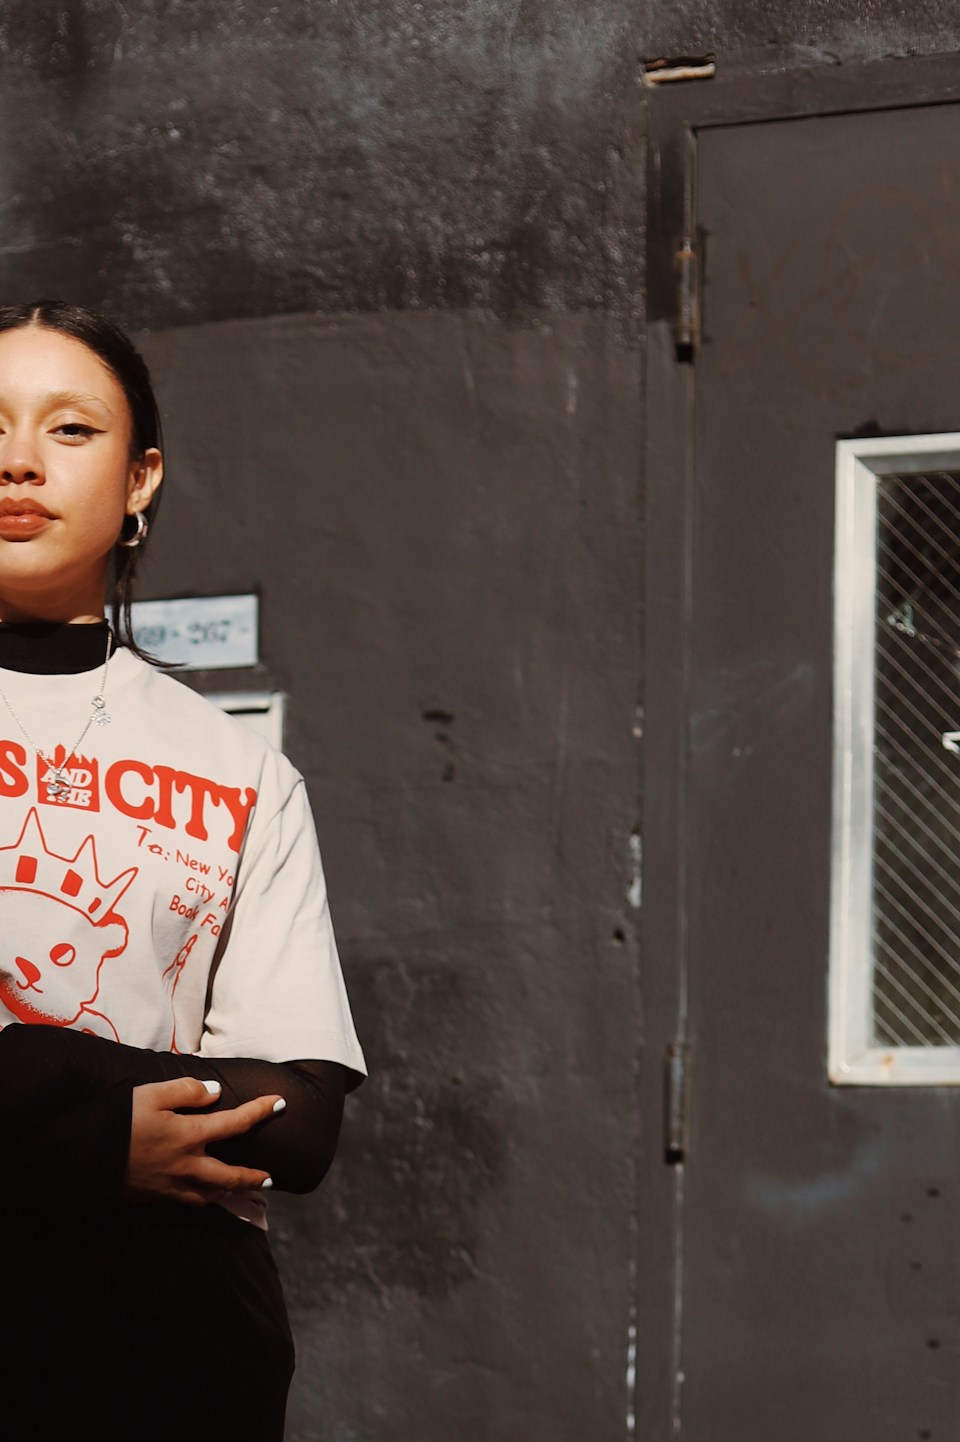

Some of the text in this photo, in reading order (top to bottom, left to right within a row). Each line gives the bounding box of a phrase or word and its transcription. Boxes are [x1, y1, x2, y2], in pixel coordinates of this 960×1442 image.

[103, 758, 258, 855] CITY
[175, 849, 212, 876] New
[217, 865, 236, 888] Yo
[184, 876, 216, 905] City
[168, 894, 200, 921] Book
[200, 912, 223, 938] Fa
